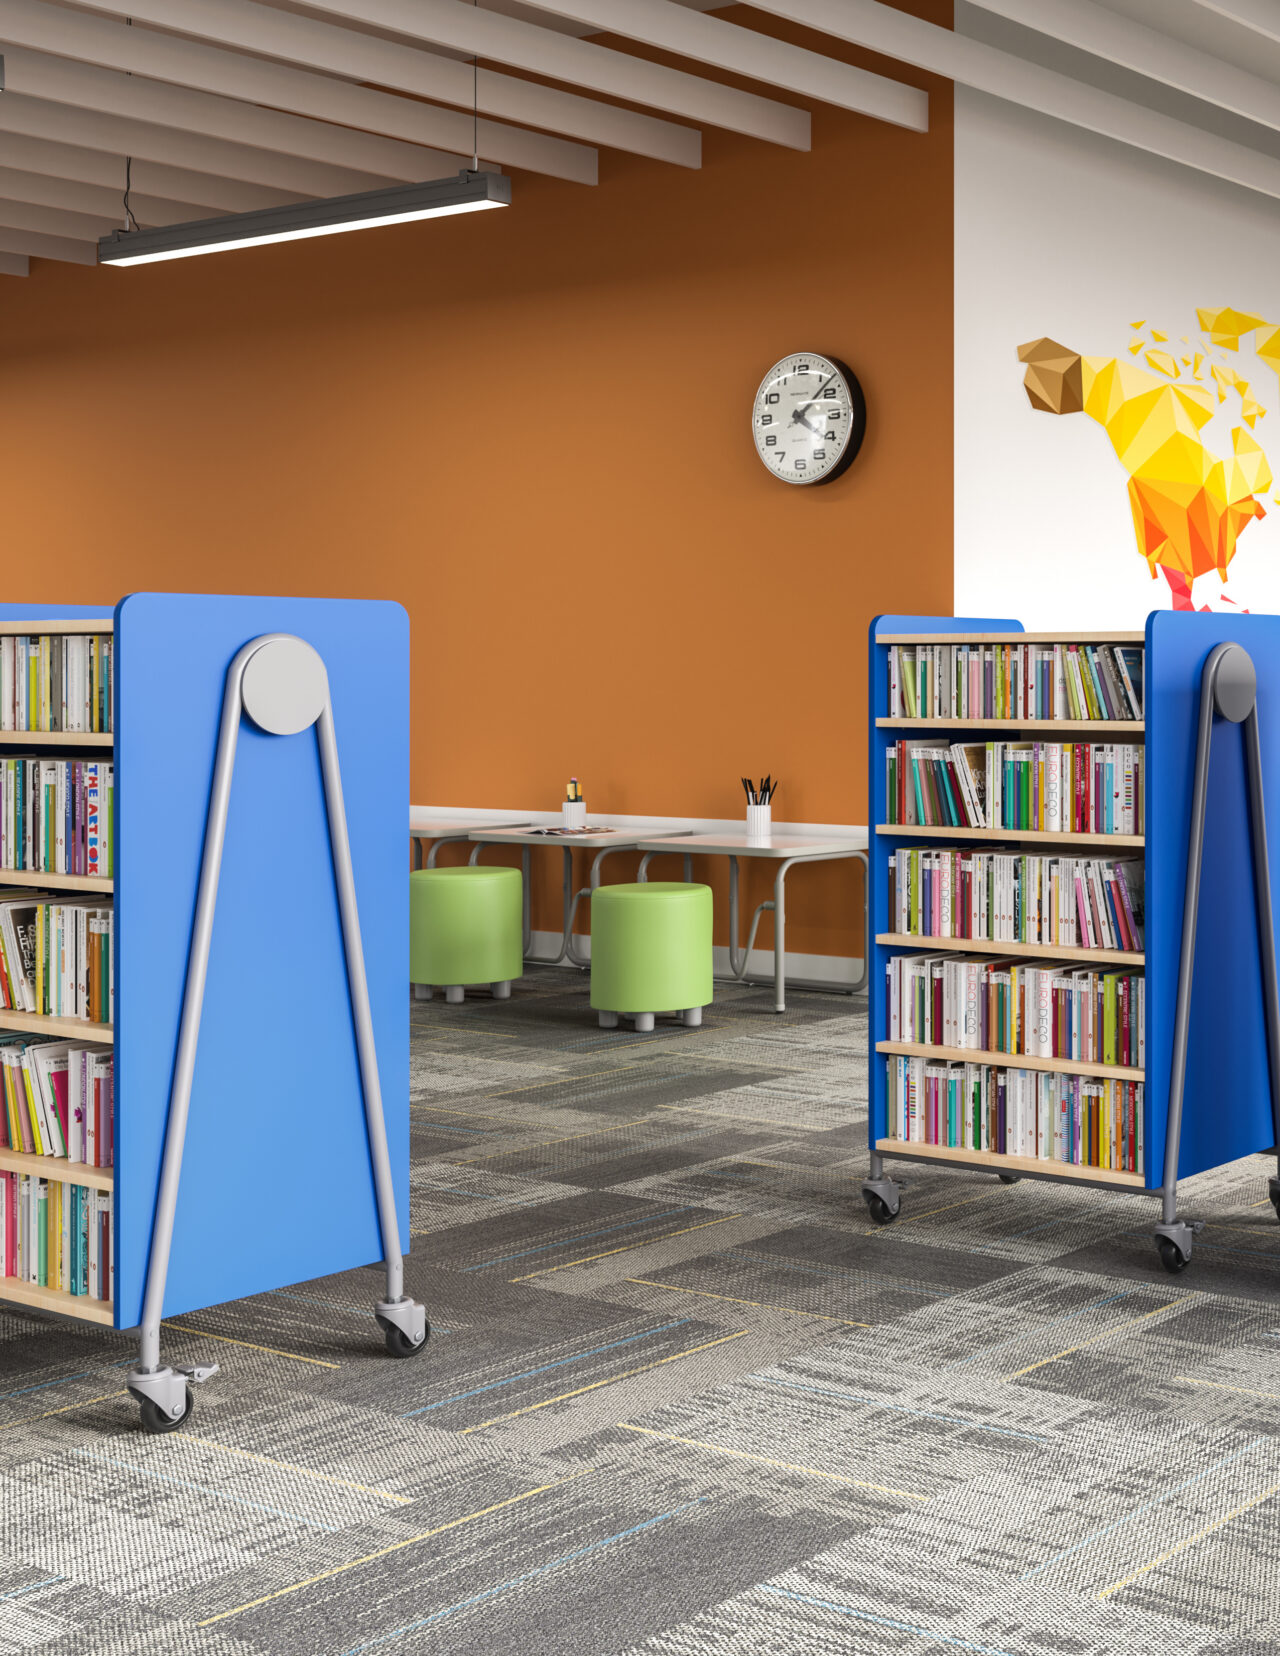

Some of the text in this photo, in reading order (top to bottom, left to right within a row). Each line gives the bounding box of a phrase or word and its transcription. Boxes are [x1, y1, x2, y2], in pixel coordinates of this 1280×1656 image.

[793, 364, 809, 376] 12
[765, 393, 780, 405] 10
[823, 388, 836, 399] 2
[761, 414, 772, 426] 9
[828, 408, 841, 420] 3
[765, 435, 777, 446] 8
[824, 430, 837, 441] 4
[774, 451, 786, 463] 7
[813, 449, 826, 460] 5
[794, 459, 807, 470] 6
[1047, 746, 1057, 817] EURODECO
[89, 764, 98, 874] THE ART BOOK
[940, 854, 950, 923] EURODECO
[968, 965, 977, 1035] EURODECO
[1038, 972, 1048, 1043] EURODECO
